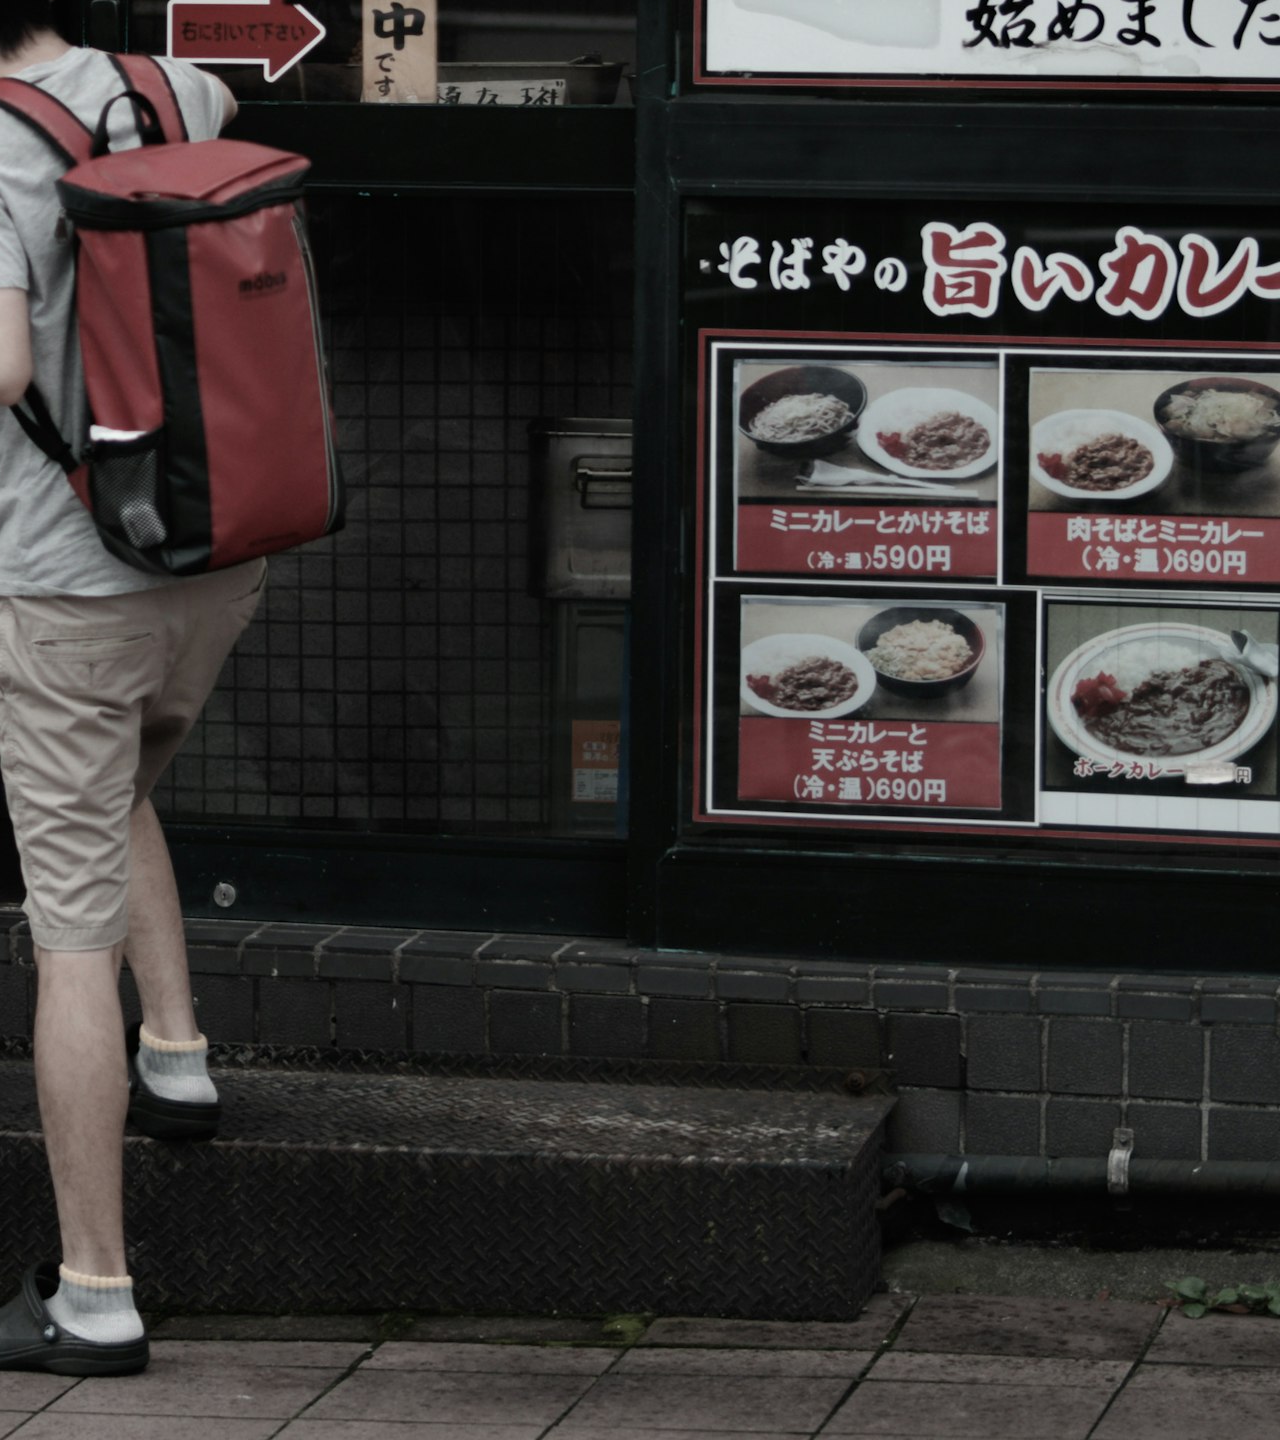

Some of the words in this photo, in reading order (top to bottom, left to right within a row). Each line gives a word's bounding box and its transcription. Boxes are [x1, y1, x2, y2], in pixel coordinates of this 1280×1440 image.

[181, 21, 306, 43] 右に引いて下さい
[770, 508, 990, 534] ミニカレーとかけそば
[1067, 516, 1265, 544] 肉そばとミニカレー
[808, 720, 928, 745] ミニカレーと
[811, 748, 924, 773] 天ぷらそば
[1235, 766, 1252, 783] 円
